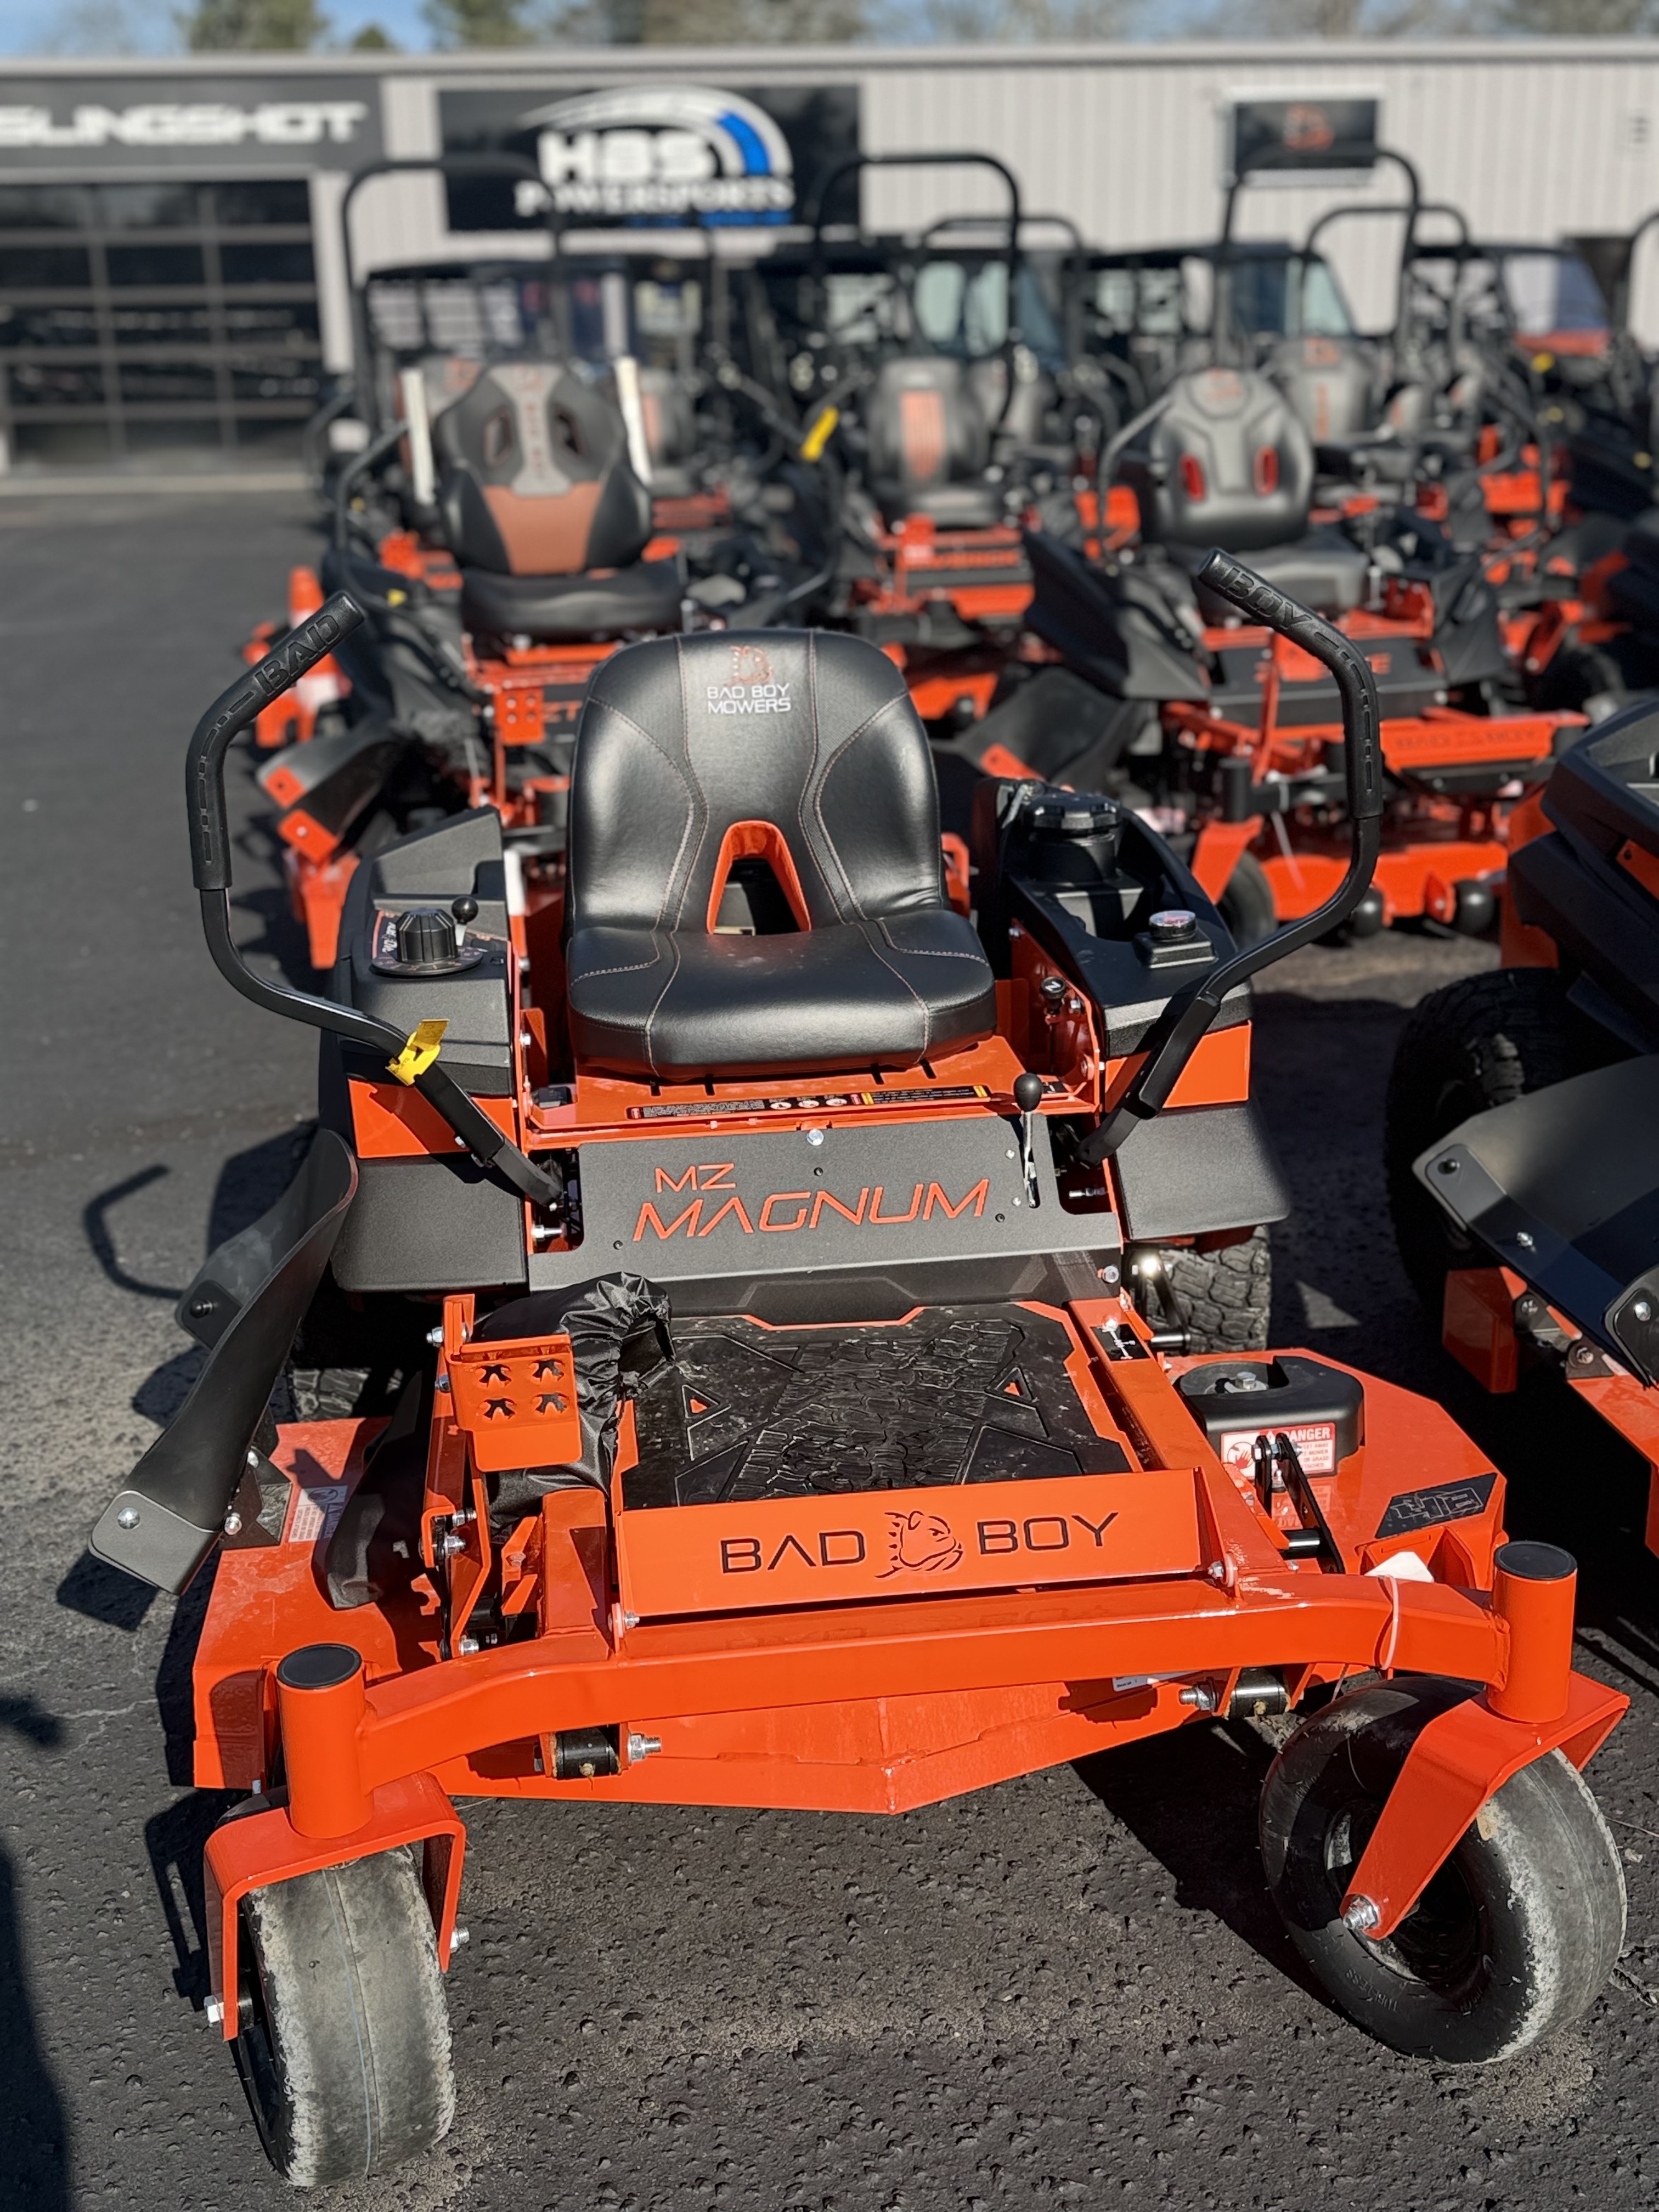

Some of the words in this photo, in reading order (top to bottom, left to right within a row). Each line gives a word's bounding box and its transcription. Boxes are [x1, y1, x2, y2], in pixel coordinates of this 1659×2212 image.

[515, 178, 795, 216] PWERSPORTS
[1220, 567, 1312, 629] BOY
[255, 614, 340, 697] BAD
[707, 686, 745, 699] BAD
[751, 682, 790, 698] BOY
[708, 697, 792, 714] MOWERS
[655, 1163, 736, 1193] MZ
[633, 1178, 989, 1242] MAGNUM
[720, 1530, 866, 1574] BAD
[977, 1511, 1119, 1555] BOY
